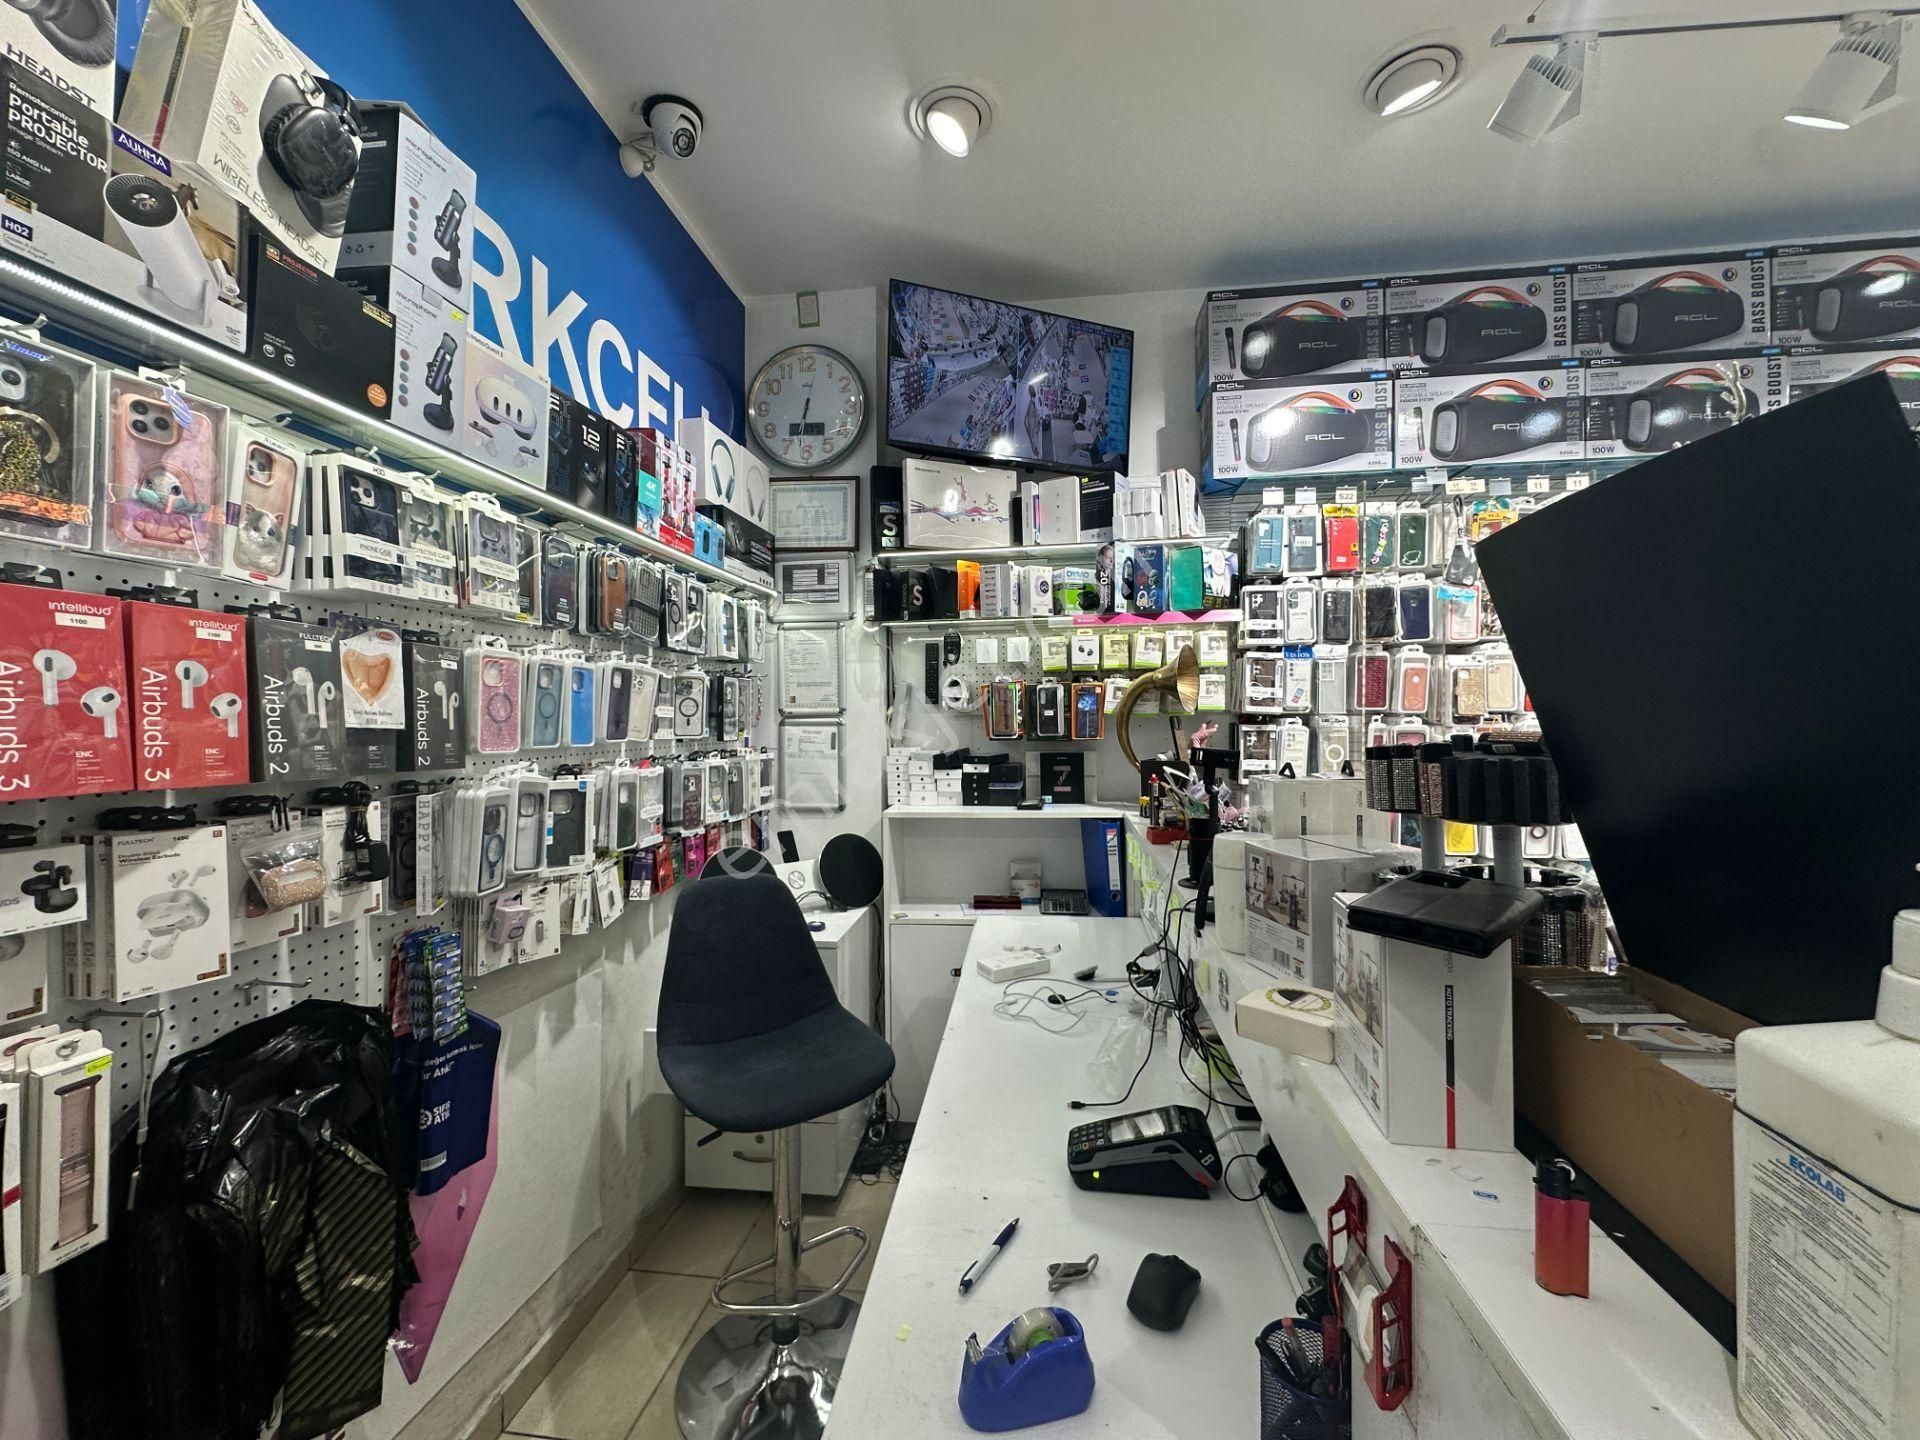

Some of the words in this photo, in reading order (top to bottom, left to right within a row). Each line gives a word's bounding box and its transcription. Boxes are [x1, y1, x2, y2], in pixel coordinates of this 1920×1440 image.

[9, 82, 77, 125] Remotecontrol
[9, 93, 89, 148] Portable
[9, 109, 107, 173] PROJECTOR
[118, 133, 167, 171] AUHMA
[213, 153, 274, 219] WIRELESS
[277, 218, 329, 269] HEADSET
[5, 219, 30, 238] H02
[1751, 258, 1764, 298] BOOST
[1553, 274, 1566, 314] BOOST
[396, 291, 438, 319] microphone
[1366, 289, 1378, 323] BOOST
[1674, 313, 1719, 322] ACL
[1752, 301, 1765, 333] BASS
[1481, 328, 1522, 337] ACL
[1554, 318, 1567, 347] BASS
[1298, 341, 1337, 349] ACL
[1366, 325, 1379, 360] BASS
[780, 362, 793, 379] 11
[799, 356, 816, 373] 12
[827, 361, 833, 379] 1
[1590, 358, 1621, 366] ACL
[838, 376, 850, 393] 2
[1213, 373, 1234, 381] 100W
[1767, 356, 1782, 396] BOOST
[766, 380, 781, 396] 10
[1216, 383, 1245, 391] ACL
[1566, 368, 1580, 408] BOOST
[1374, 381, 1388, 418] BOOST
[757, 400, 770, 417] 9
[582, 424, 601, 448] 12
[764, 422, 777, 439] 8
[1374, 418, 1388, 453] BASS
[1566, 409, 1580, 446] BASS
[783, 438, 794, 455] 7
[822, 437, 834, 454] 5
[1305, 434, 1345, 442] ACL
[801, 445, 813, 460] 6
[1591, 446, 1615, 454] 100W
[1400, 456, 1422, 464] 100W
[1218, 466, 1239, 474] 100W
[1533, 482, 1542, 490] 11
[1067, 570, 1090, 579] DYMO
[49, 601, 111, 616] intellibud
[189, 619, 238, 632] intellibud
[142, 667, 169, 758] Airbuds
[264, 674, 288, 754] Airbuds
[417, 687, 430, 751] Airbuds
[269, 761, 290, 776] 2
[418, 756, 430, 767] 2
[0, 774, 31, 792] 3
[144, 768, 171, 783] 3
[418, 800, 431, 853] HAPPY
[1788, 1154, 1846, 1203] ECOLAB
